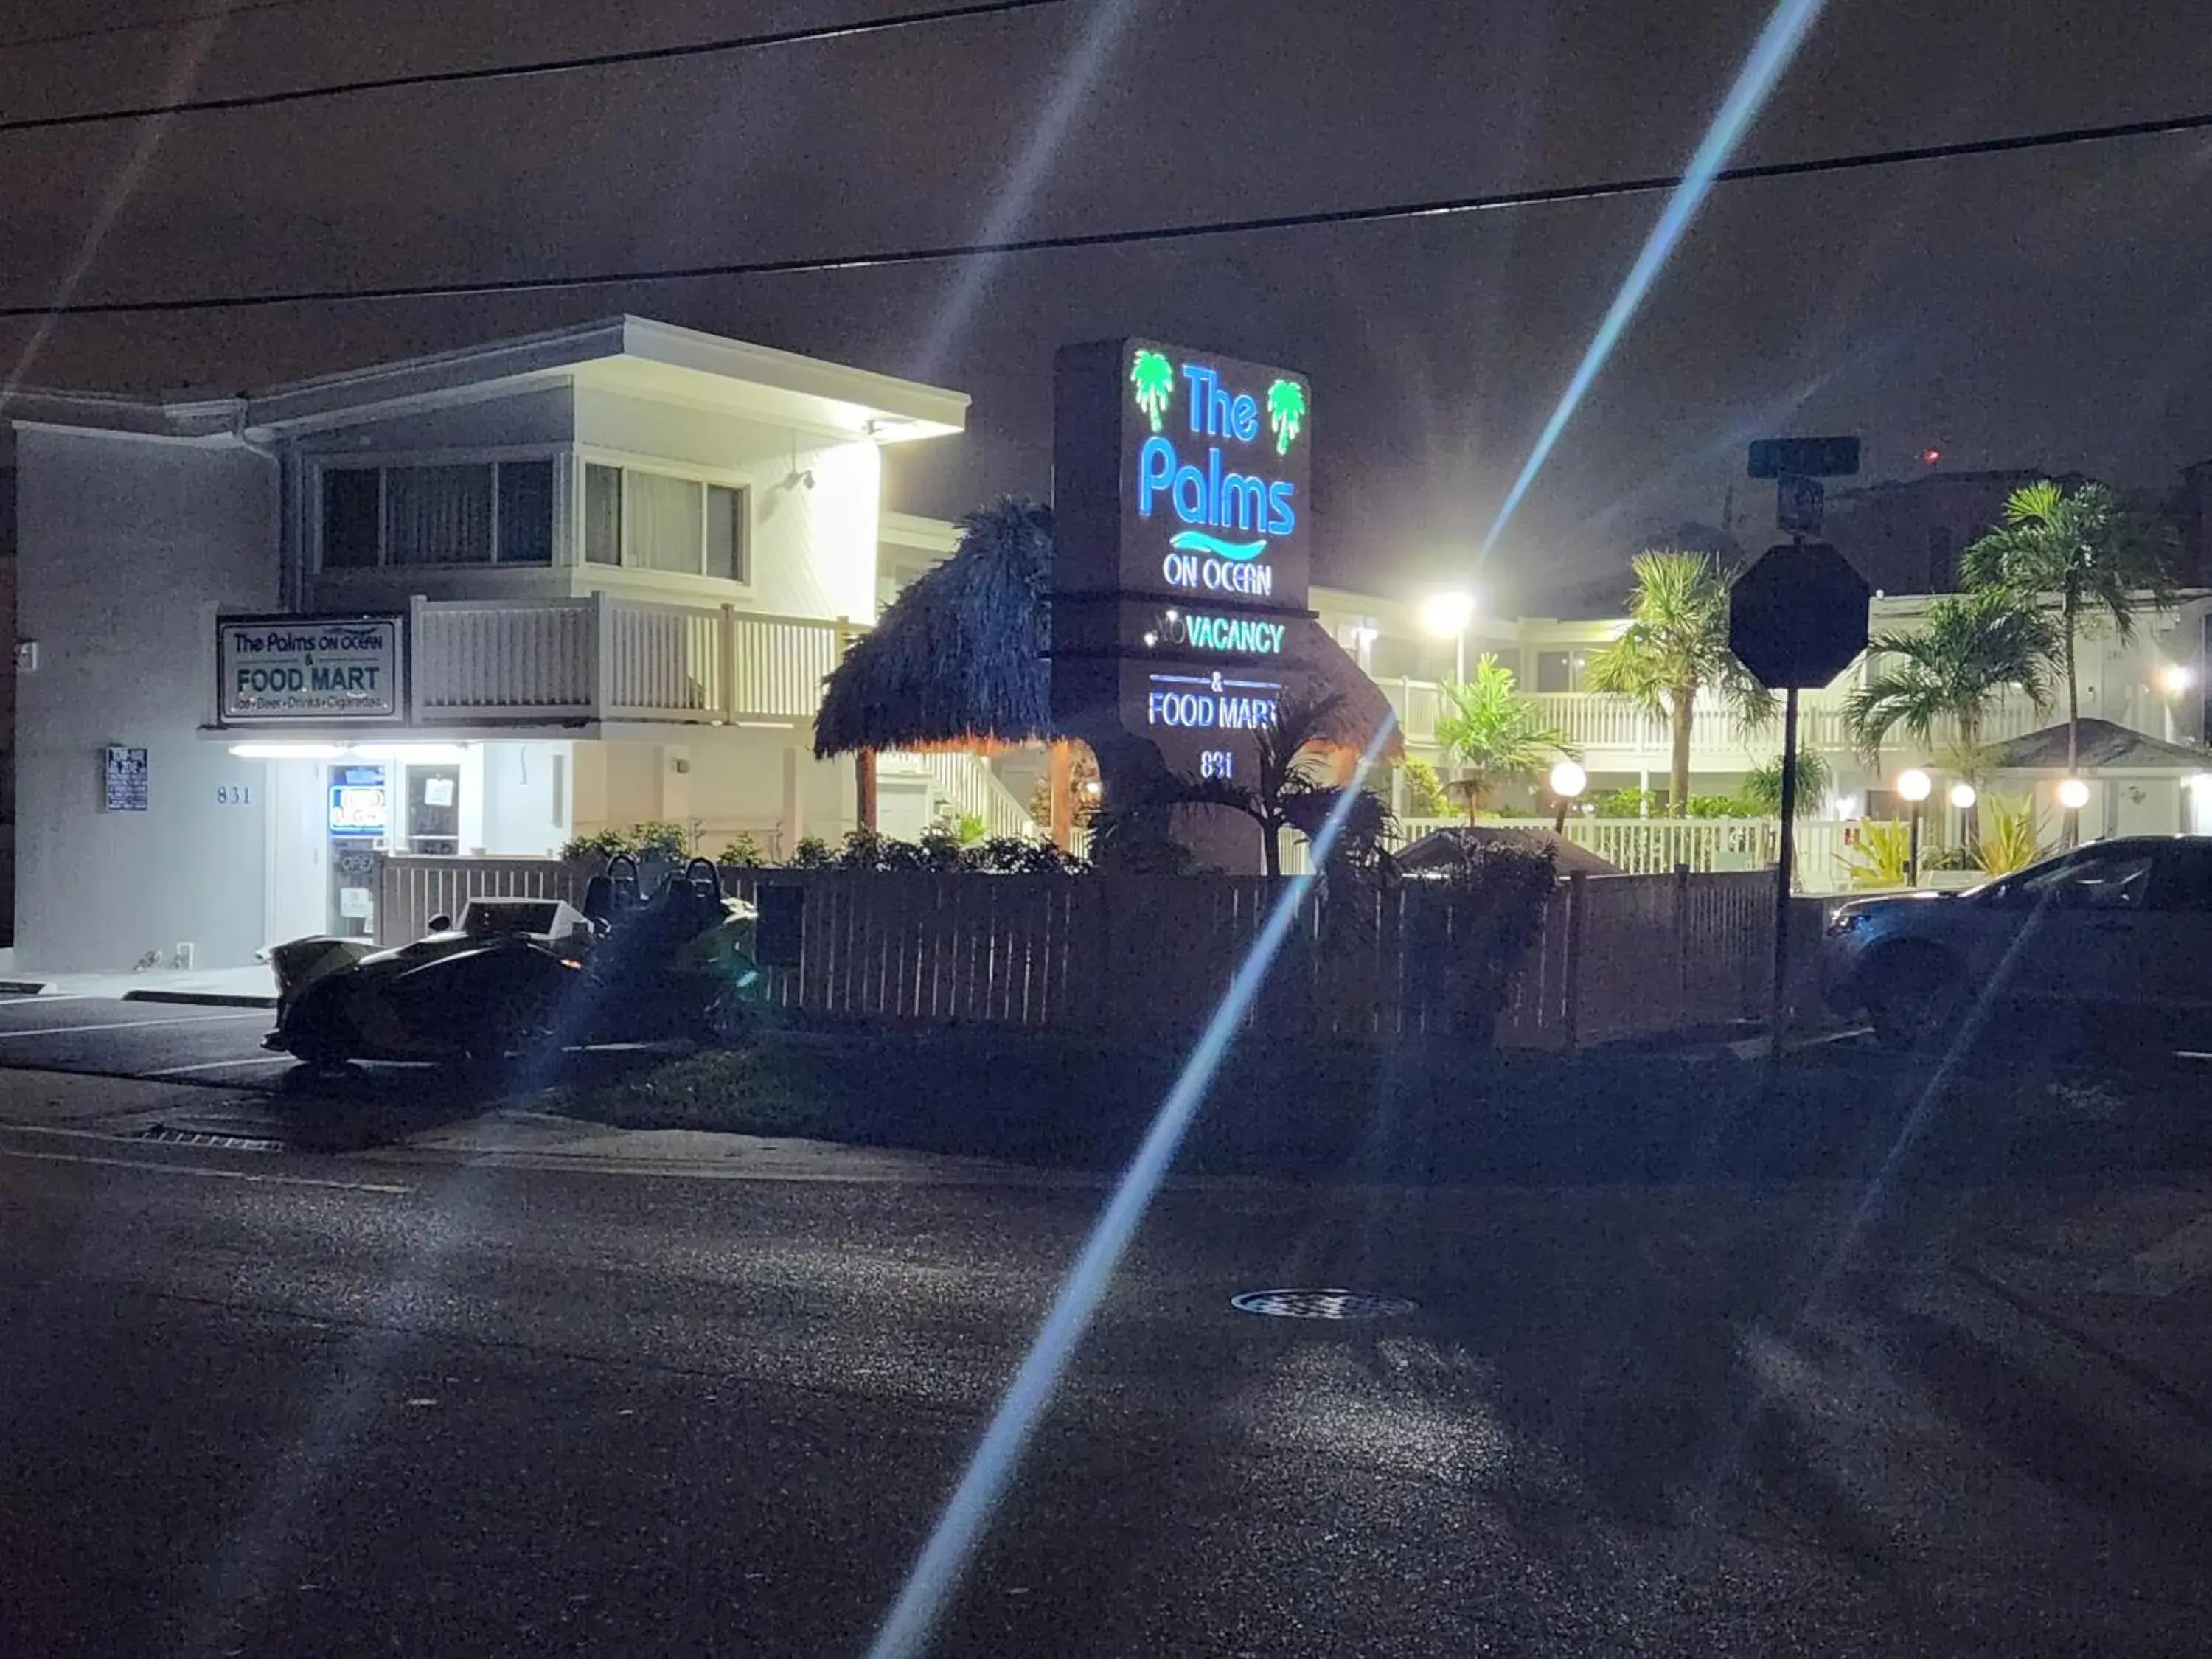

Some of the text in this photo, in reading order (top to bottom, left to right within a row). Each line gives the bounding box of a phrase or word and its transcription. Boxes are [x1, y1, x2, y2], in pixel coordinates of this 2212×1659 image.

[1181, 364, 1258, 442] The
[1139, 436, 1295, 535] Palms
[1163, 554, 1272, 597] ON OCEAN
[234, 632, 383, 653] The Palms ON OCEAN
[1186, 615, 1285, 654] VACANCY
[237, 666, 380, 692] FOOD MART
[1211, 670, 1222, 692] &
[1149, 692, 1213, 727] FOOD
[1200, 751, 1232, 779] 831
[217, 786, 249, 804] 831
